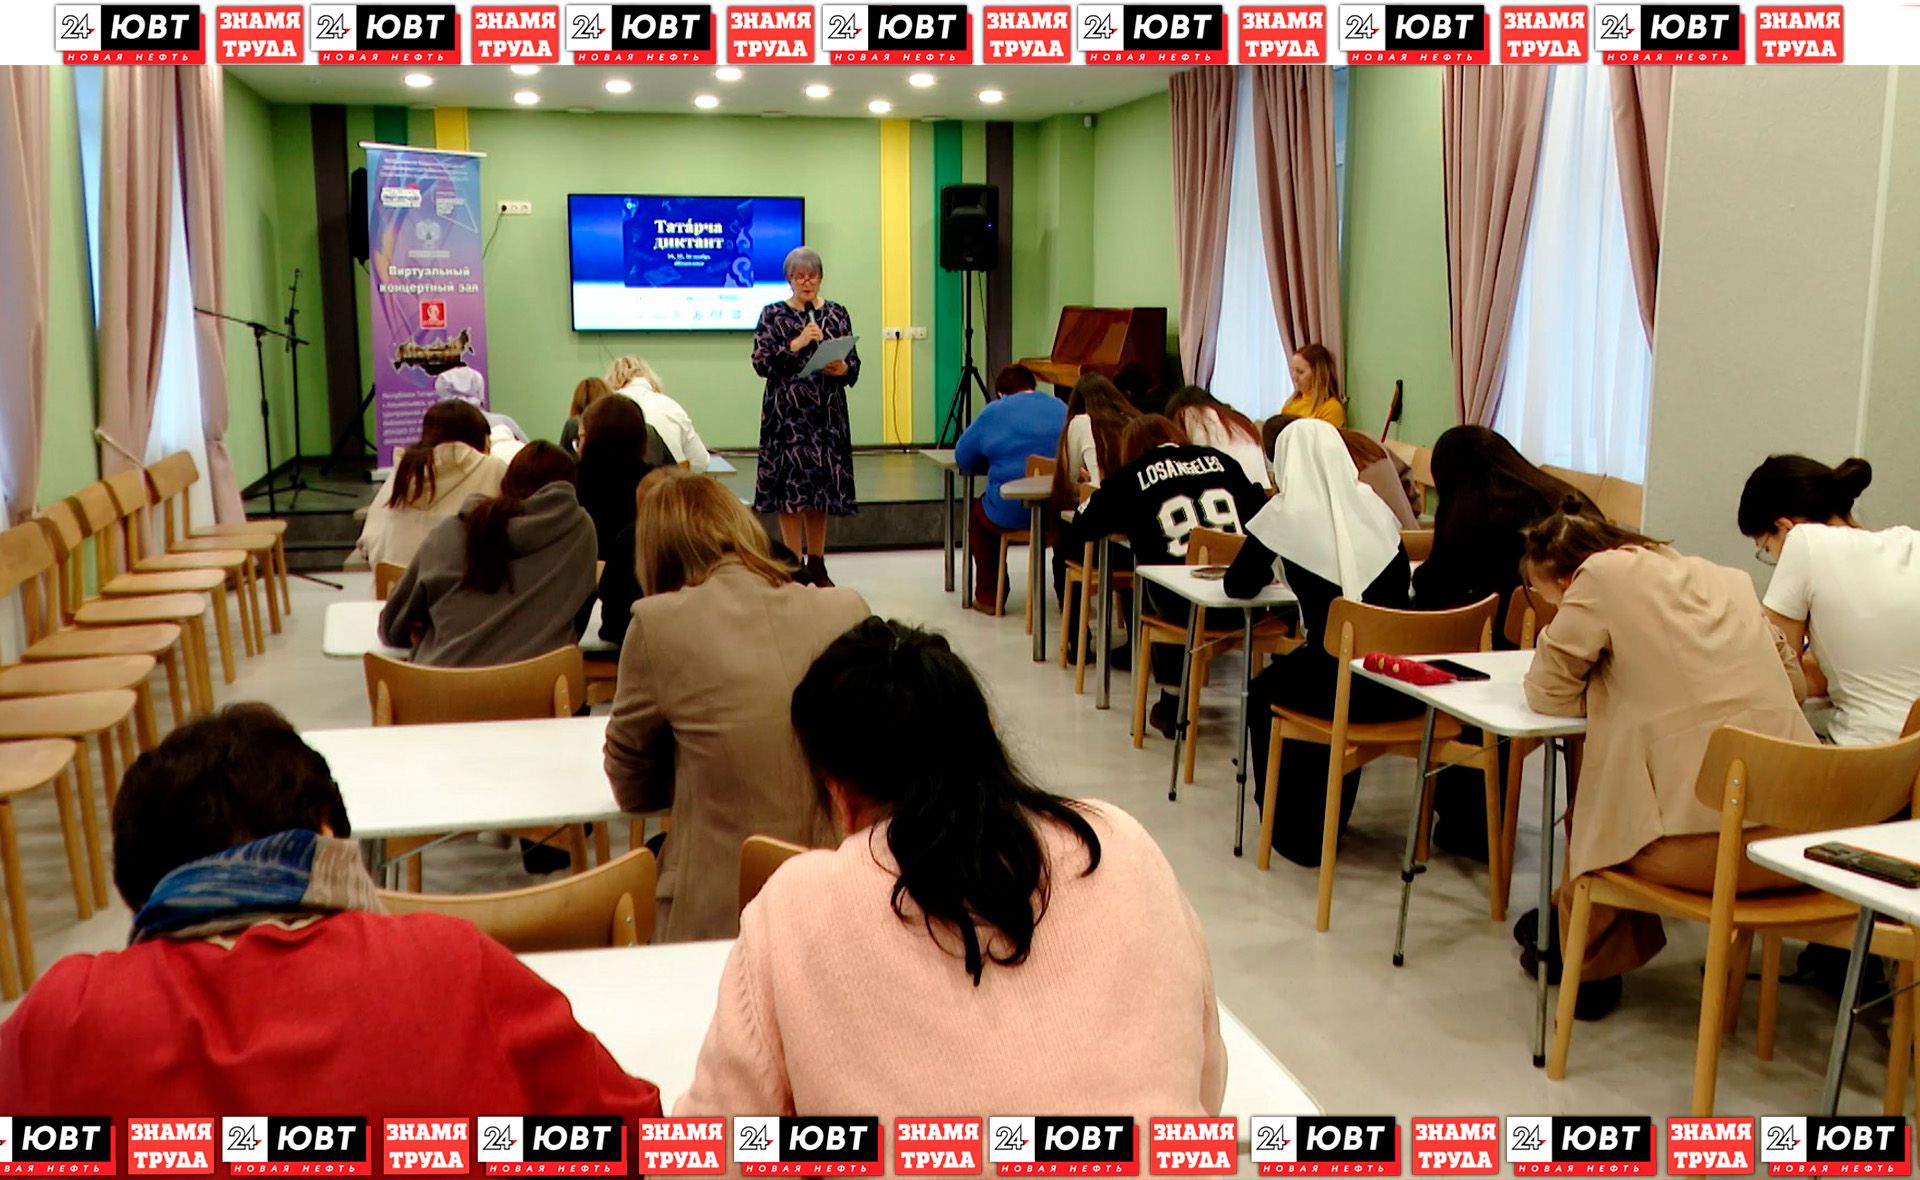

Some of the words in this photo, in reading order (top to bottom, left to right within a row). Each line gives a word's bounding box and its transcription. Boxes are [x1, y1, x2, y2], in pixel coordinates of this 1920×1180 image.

[653, 237, 725, 251] диктант
[388, 265, 470, 280] Виртуальный
[379, 281, 455, 295] концертный
[458, 283, 479, 293] зал
[1156, 488, 1244, 557] 99
